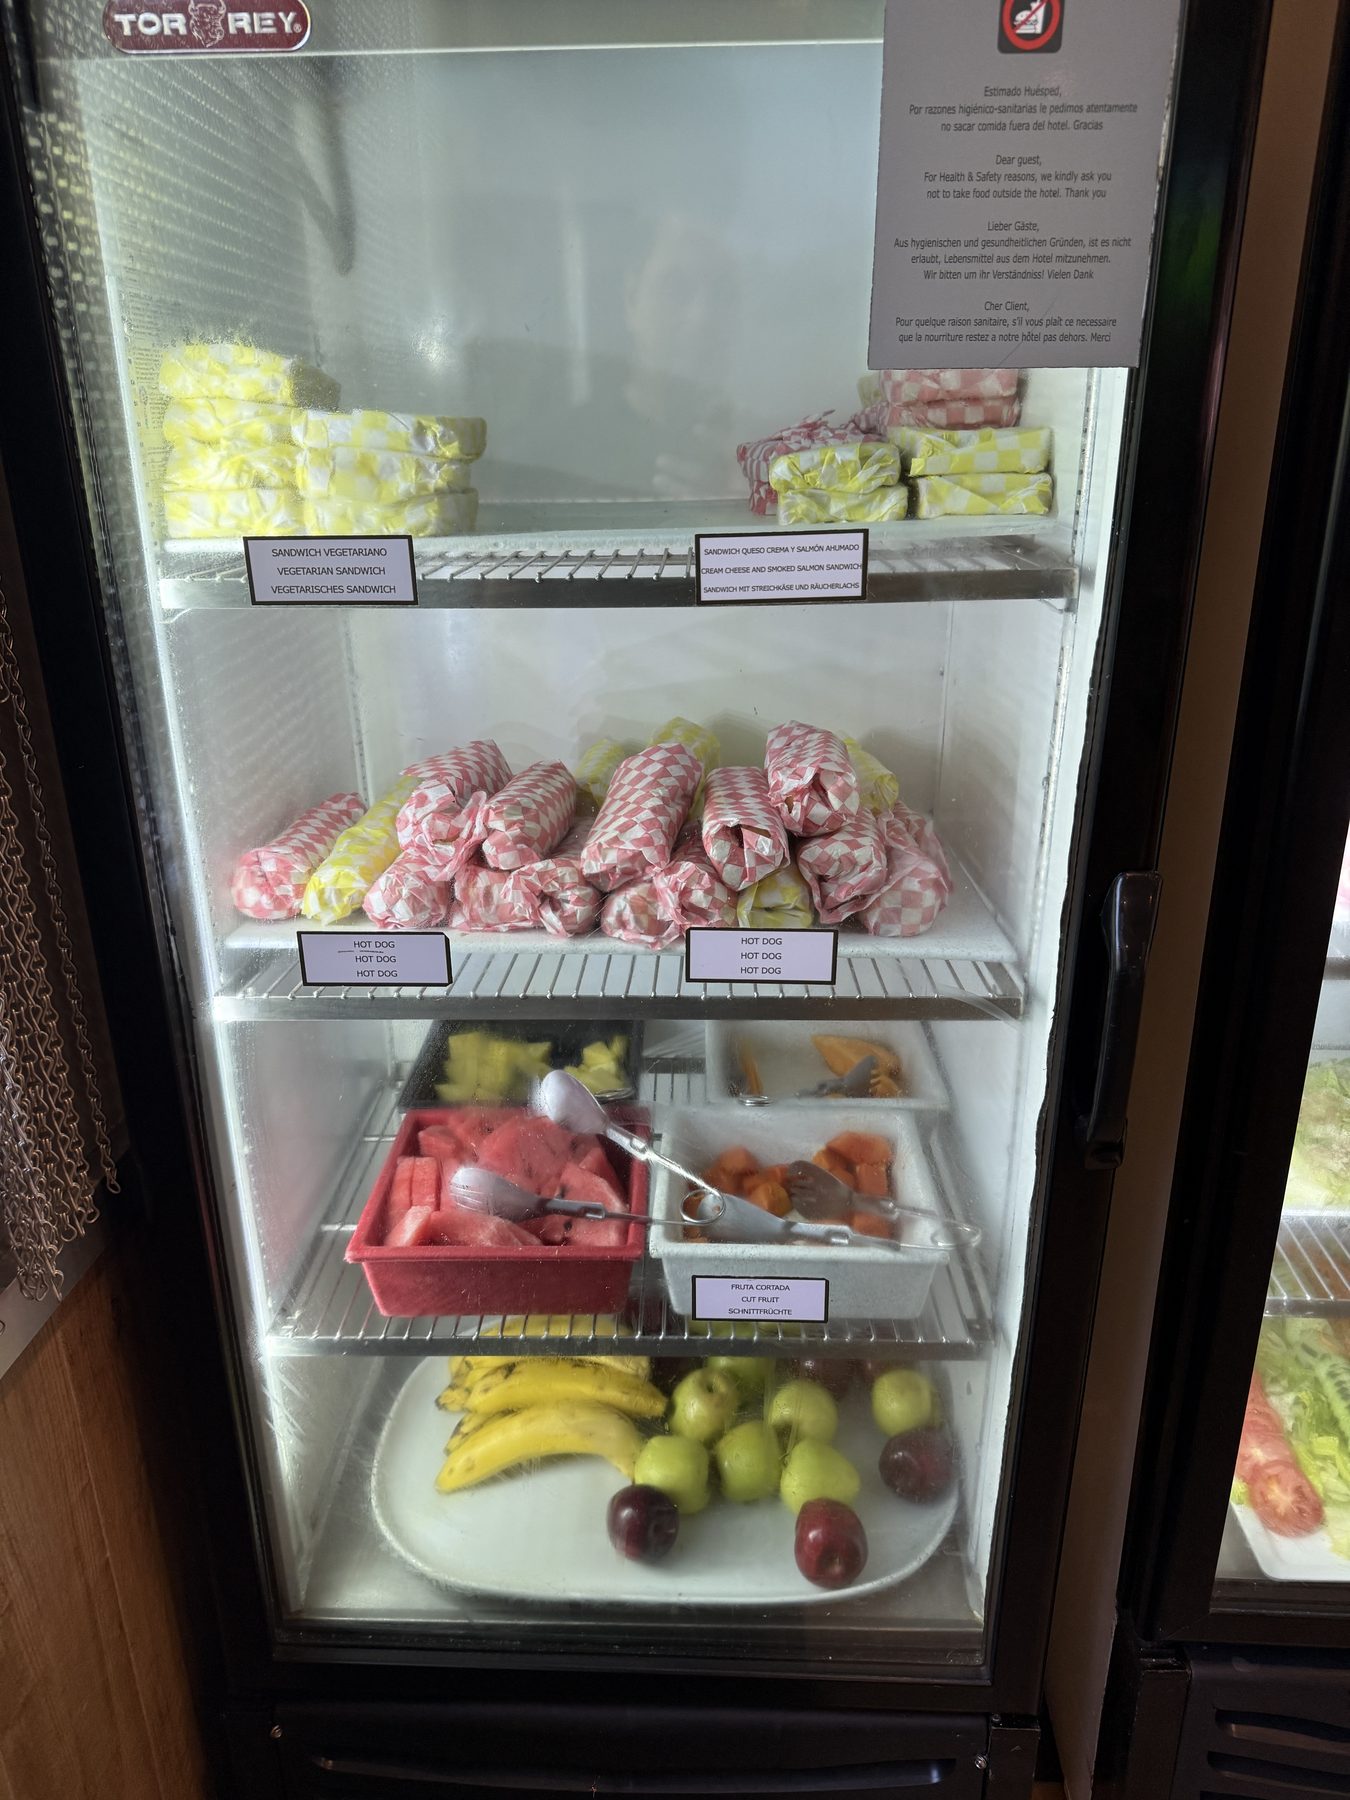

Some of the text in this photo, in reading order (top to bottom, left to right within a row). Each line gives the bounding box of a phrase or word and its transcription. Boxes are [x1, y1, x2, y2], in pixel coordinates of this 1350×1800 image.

[114, 13, 188, 36] TOR
[984, 86, 1021, 96] Estimado
[909, 104, 922, 114] Por
[924, 106, 956, 114] razones
[1040, 104, 1047, 113] le
[1049, 104, 1083, 114] pedimos
[1086, 104, 1138, 113] atentamente
[941, 122, 951, 131] no
[954, 122, 974, 131] sacar
[978, 121, 1006, 131] comida
[1009, 121, 1030, 130] fuera
[1032, 120, 1045, 130] del
[1073, 120, 1103, 130] Gracias
[996, 155, 1042, 166] Dear guest,
[924, 171, 1112, 183] For Health & Safety reasons, we kindly ask you
[927, 189, 940, 198] not
[942, 188, 950, 198] to
[953, 188, 970, 198] take
[972, 188, 990, 198] food
[993, 188, 1022, 198] outside
[1024, 188, 1036, 198] the
[1065, 188, 1090, 198] Thank
[1092, 189, 1106, 199] you
[988, 222, 1012, 231] Lieber
[894, 238, 1131, 249] Aus hygienischen und gesundheitlichen Gründen, ist es nicht
[911, 254, 1110, 265] erlaubt, Lebensmittel aus dem Hotel mitzunehmen.
[924, 270, 937, 279] Wir
[939, 270, 962, 279] bitten
[1048, 270, 1071, 279] Vielen
[1074, 270, 1094, 279] Dank
[984, 301, 1030, 312] Cher Client,
[896, 317, 913, 326] Pour
[915, 317, 946, 328] quelque
[948, 318, 971, 326] raison
[974, 317, 1009, 327] sanitaire,
[1025, 318, 1043, 326] vous
[1065, 318, 1073, 326] ce
[899, 334, 913, 343] que
[916, 333, 922, 342] la
[925, 333, 963, 342] nourriture
[966, 334, 989, 342] restez
[999, 334, 1020, 342] notre
[1043, 334, 1057, 344] pas
[1059, 333, 1088, 342] dehors.
[1090, 333, 1110, 342] Merci
[272, 548, 387, 557] SANDWICH VEGETARIANO
[797, 544, 824, 552] SALMÓN
[277, 567, 385, 575] VEGETARIAN SANDWICH
[271, 585, 396, 594] VEGETARISCHES SANDWICH
[811, 582, 859, 590] RÄUCHERLACHS
